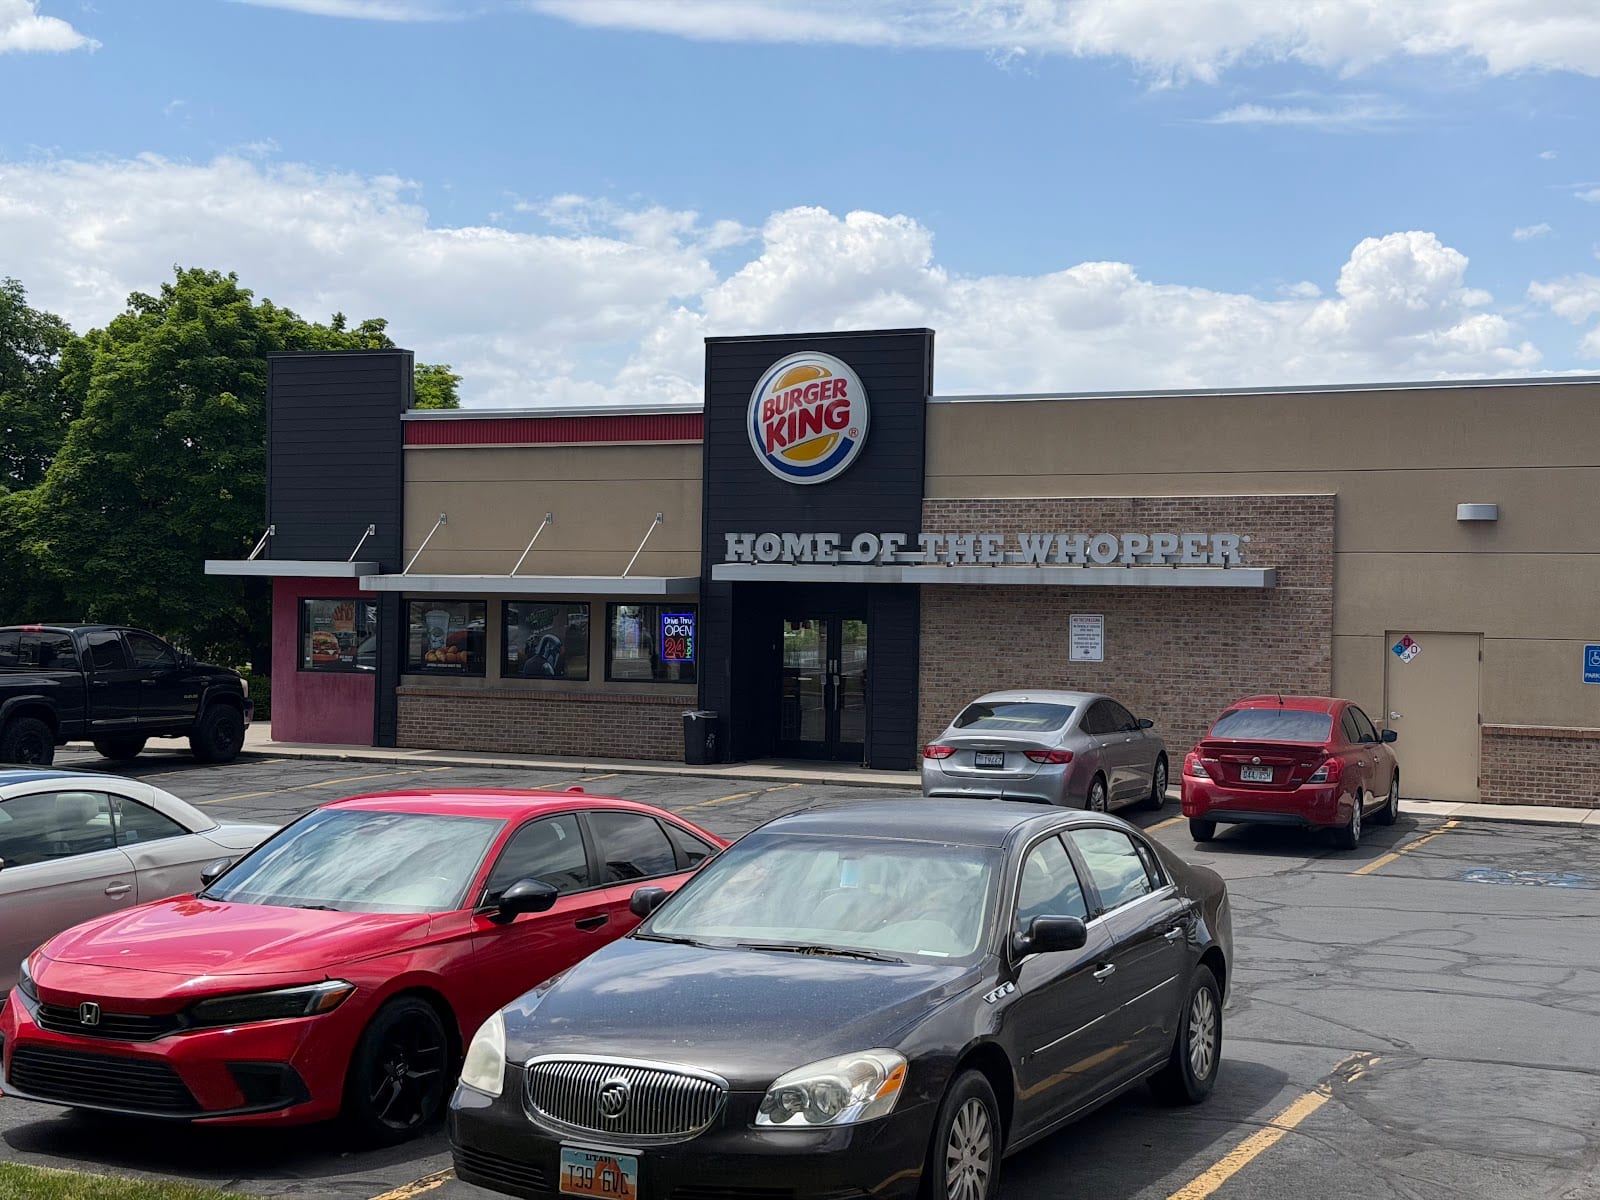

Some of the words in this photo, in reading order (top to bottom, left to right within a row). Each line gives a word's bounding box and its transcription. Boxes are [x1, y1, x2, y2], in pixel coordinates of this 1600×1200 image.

[762, 378, 848, 423] BURGER
[766, 399, 851, 454] KING
[724, 532, 842, 563] HOME
[851, 532, 907, 563] OF
[918, 533, 1005, 563] THE
[1017, 533, 1243, 564] WHOPPER
[664, 616, 679, 625] Drive
[679, 616, 692, 625] Thru
[664, 625, 692, 637] OPEN
[664, 638, 686, 658] 24
[585, 1153, 611, 1164] UTAH
[568, 1164, 593, 1189] T39
